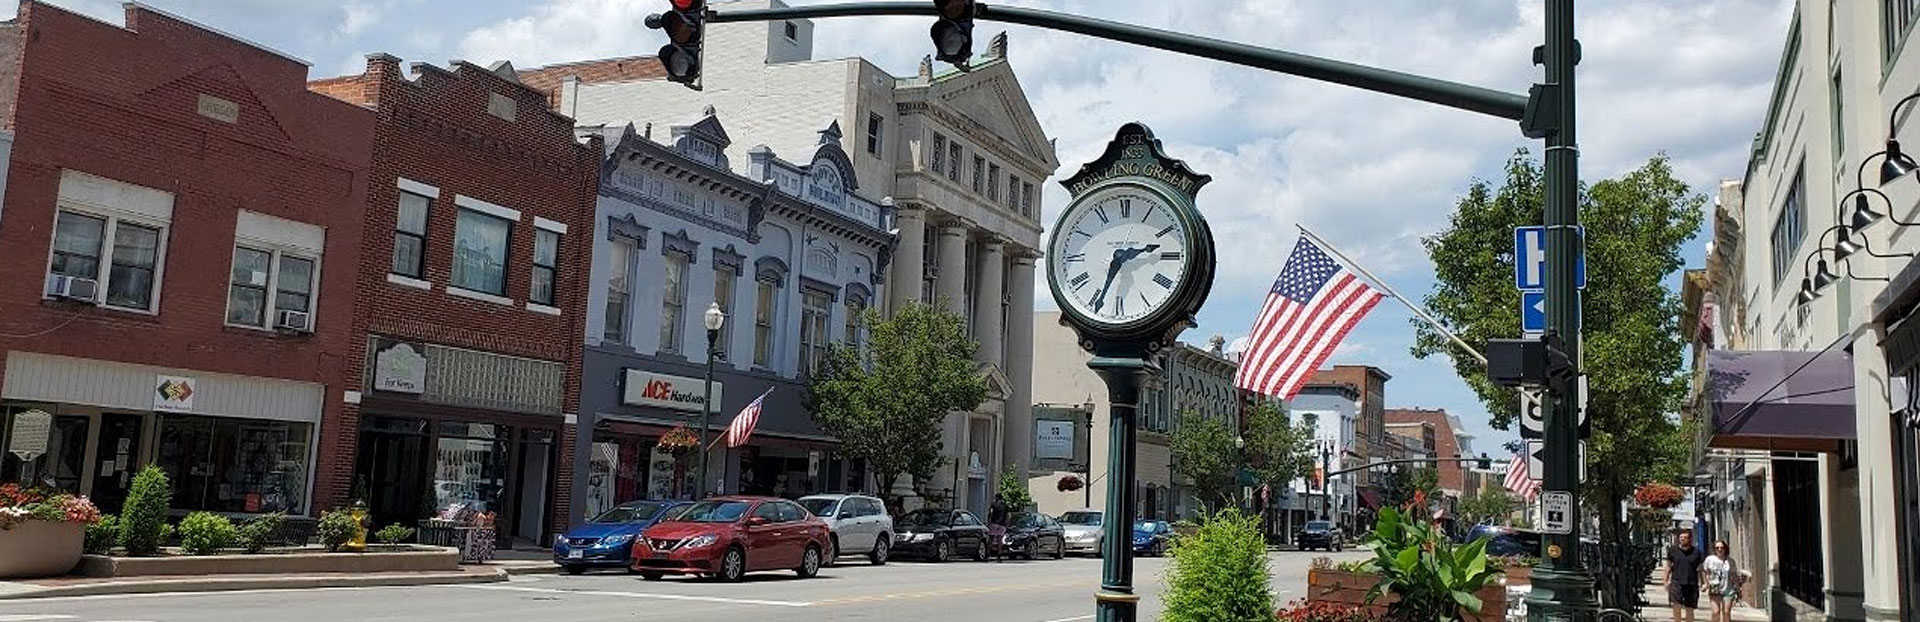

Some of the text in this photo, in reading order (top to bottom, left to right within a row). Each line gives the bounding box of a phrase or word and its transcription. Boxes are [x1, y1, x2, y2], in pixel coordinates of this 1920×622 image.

[1073, 163, 1193, 194] BOWLING GREEN
[641, 376, 706, 405] ACE Hardwa
